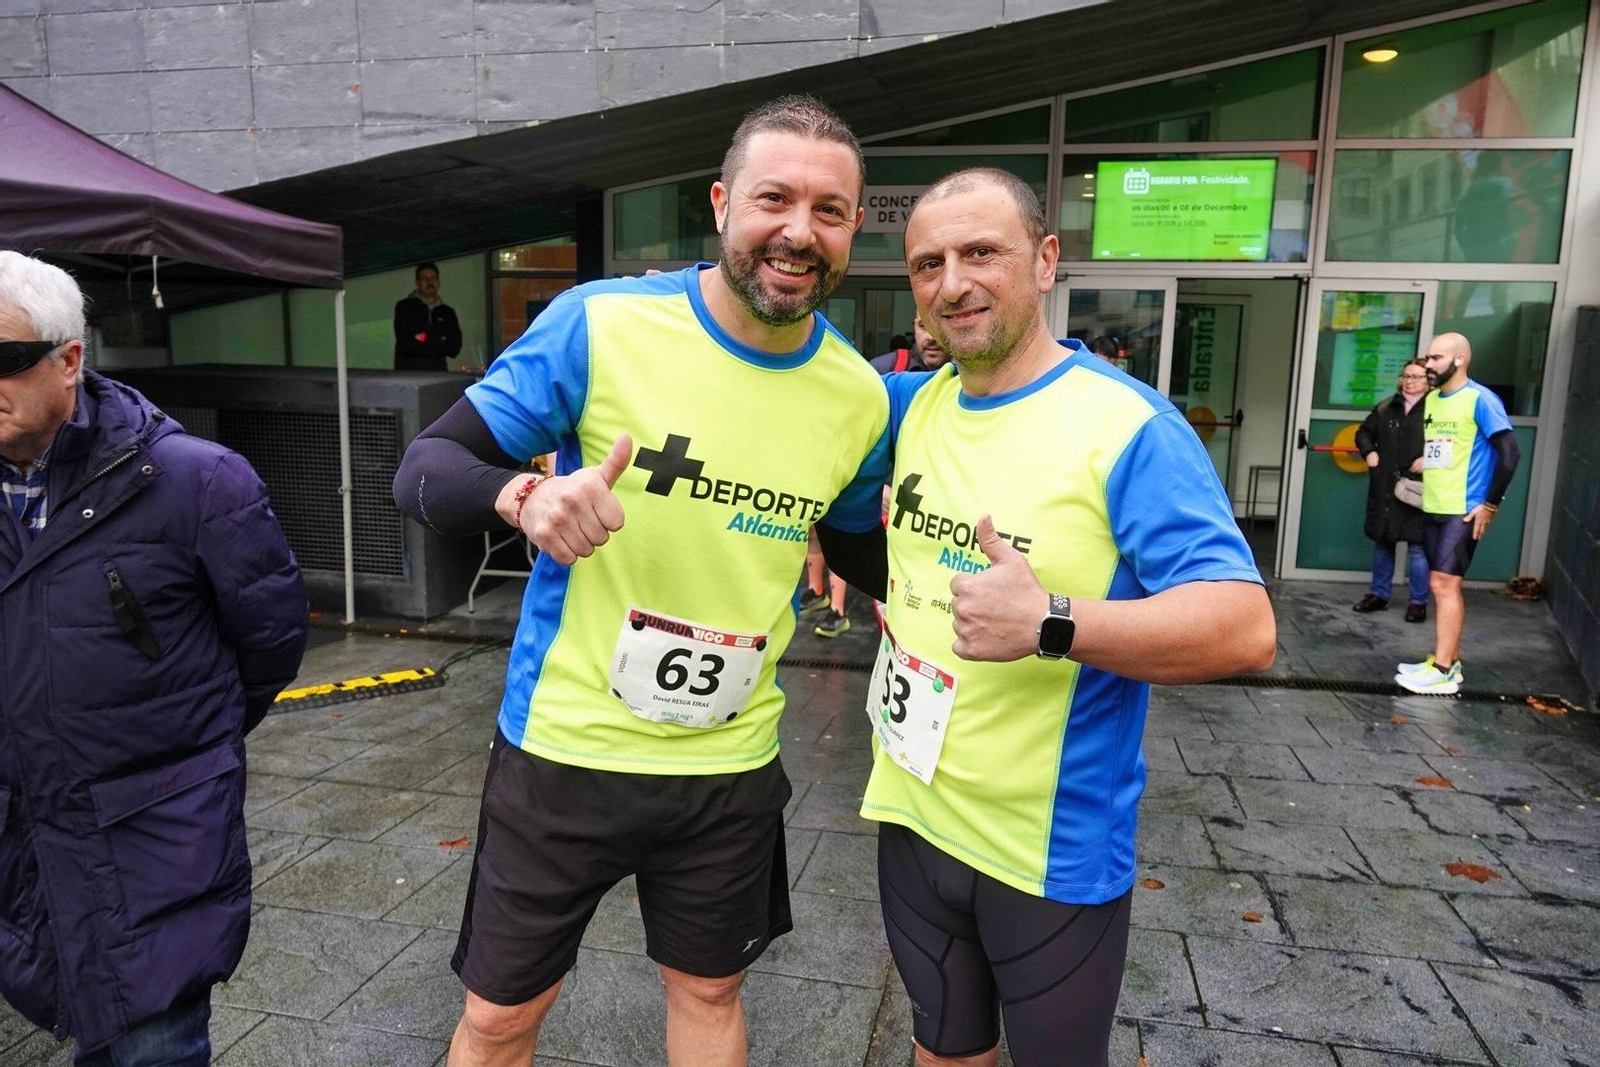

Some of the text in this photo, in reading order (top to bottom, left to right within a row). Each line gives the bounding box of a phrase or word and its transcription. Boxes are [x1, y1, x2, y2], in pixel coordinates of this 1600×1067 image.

[878, 211, 897, 223] DE
[1427, 444, 1441, 458] 26
[690, 476, 824, 522] DEPORTE
[911, 509, 1032, 555] DEPOE
[656, 648, 725, 696] 63
[653, 694, 710, 708] David RESUA EIRAS
